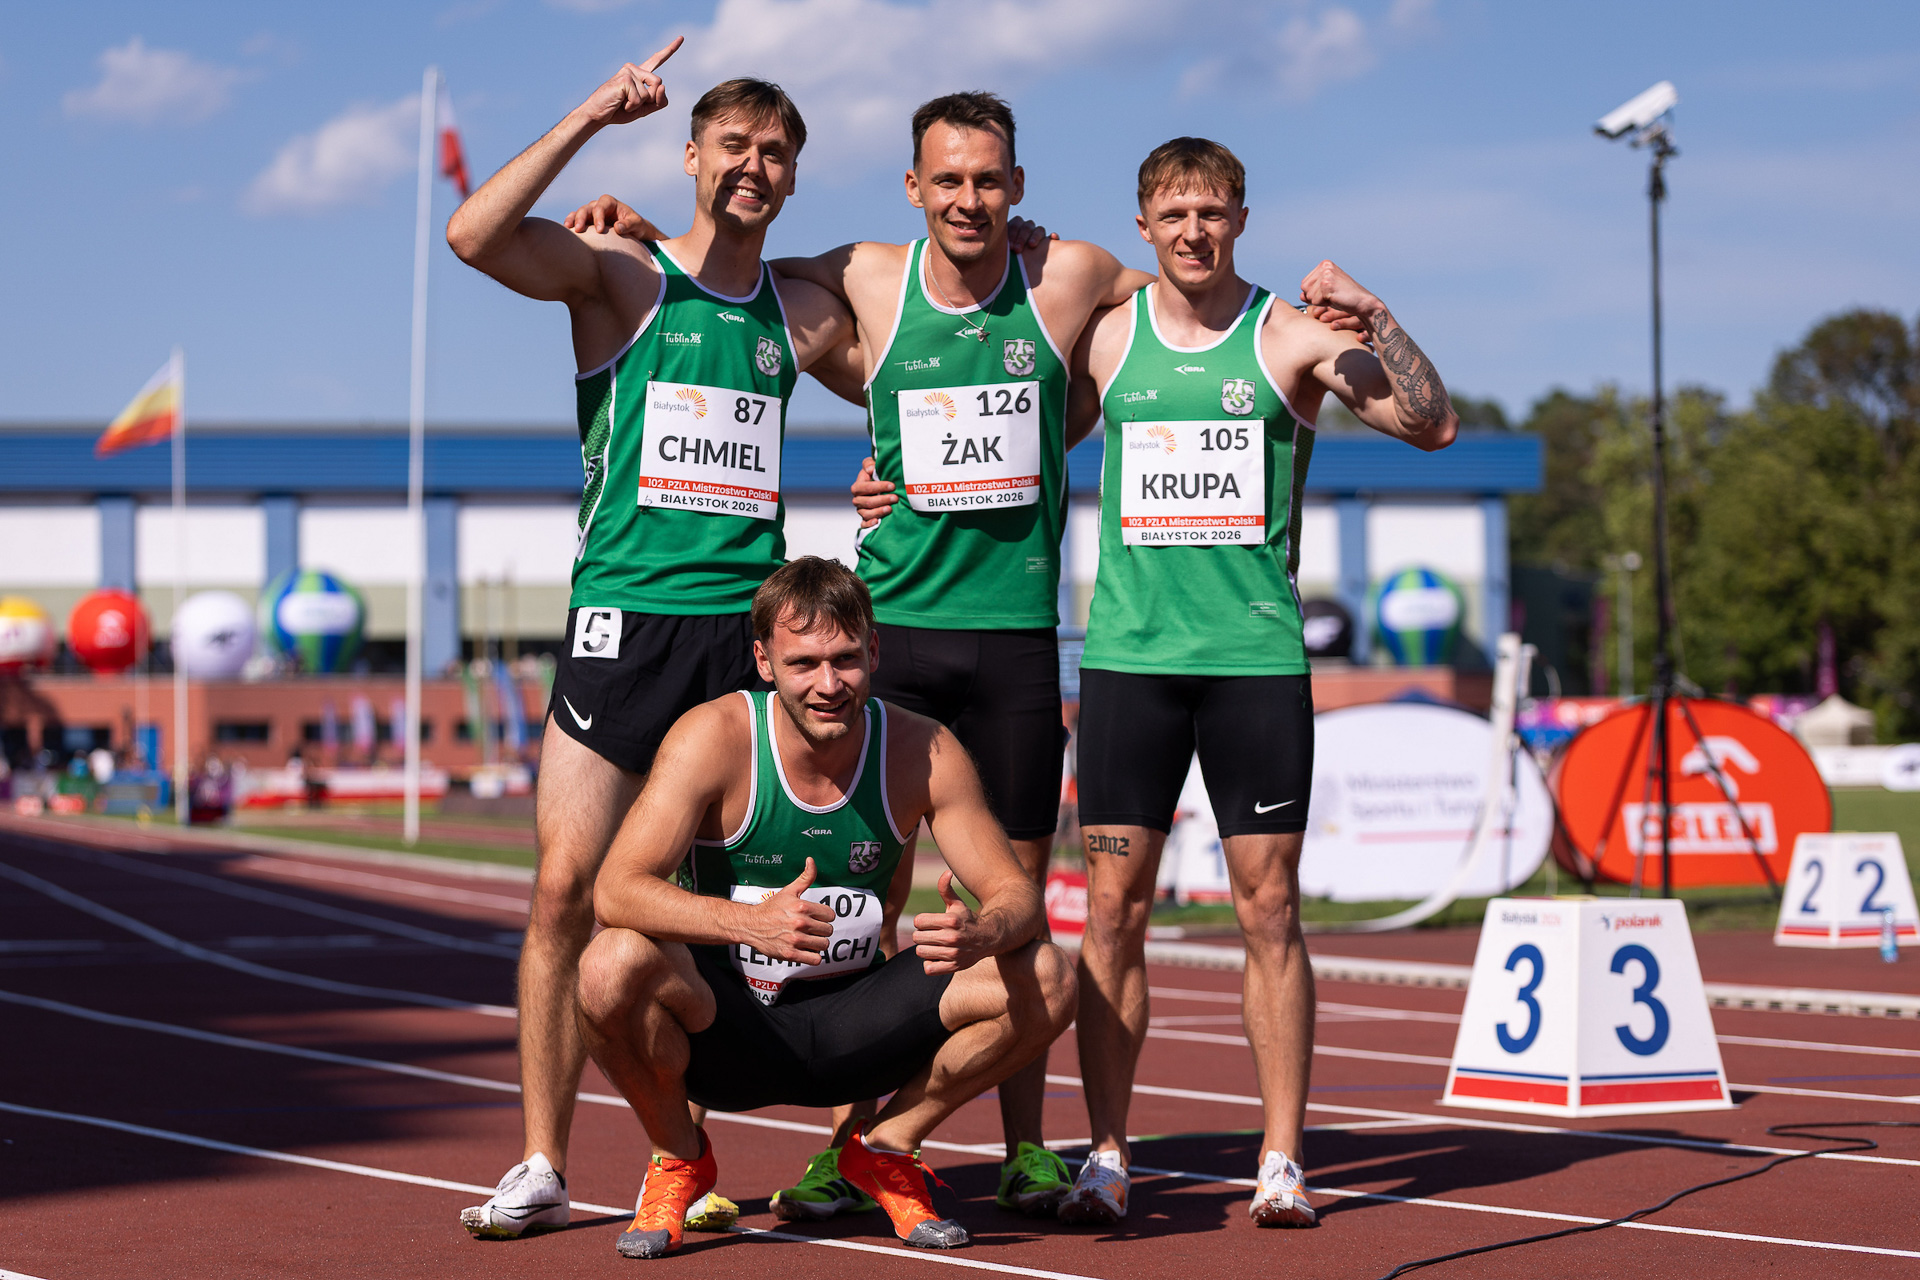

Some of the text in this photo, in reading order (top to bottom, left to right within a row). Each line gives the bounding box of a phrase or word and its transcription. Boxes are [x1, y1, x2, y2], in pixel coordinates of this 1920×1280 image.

[725, 314, 745, 323] IBRA
[653, 400, 690, 413] Białystok
[734, 396, 767, 426] 87
[906, 407, 940, 419] Białystok
[976, 387, 1032, 417] 126
[941, 432, 1004, 466] ŻAK
[1129, 439, 1160, 451] Białystok
[1199, 427, 1249, 451] 105
[658, 435, 766, 473] CHMIEL
[647, 477, 772, 501] 102. PZLA Mistrzostwa Polski
[913, 476, 1035, 494] 102. PZLA Mistrzostwa Polski
[1141, 472, 1241, 500] KRUPA
[660, 493, 759, 513] BIAŁYSTOK 2026
[927, 491, 1024, 507] BIAŁYSTOK 2026
[1128, 516, 1256, 527] 102. PZLA Mistrzostwa Polski
[1141, 530, 1242, 541] BIAŁYSTOK 2026
[582, 612, 611, 653] 5
[1087, 833, 1130, 857] 2002
[1801, 859, 1824, 913] 2
[1856, 859, 1892, 913] 2
[1615, 913, 1663, 931] polanik
[755, 980, 779, 991] PZLA
[1496, 943, 1545, 1054] 3
[1610, 944, 1670, 1056] 3
